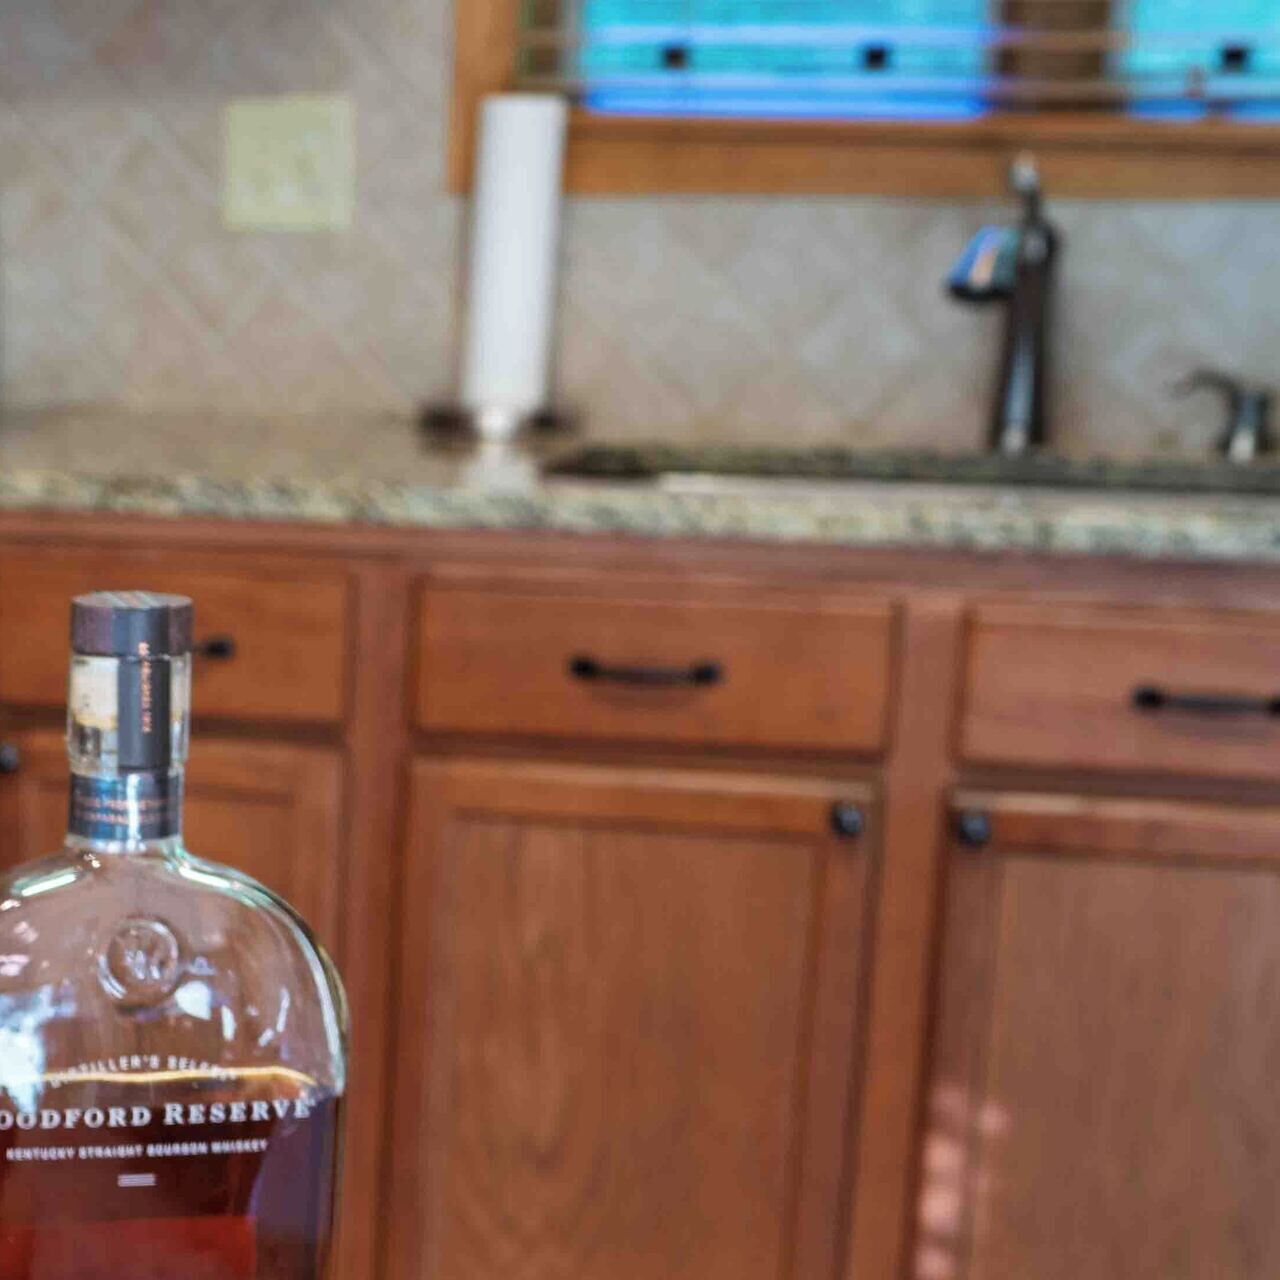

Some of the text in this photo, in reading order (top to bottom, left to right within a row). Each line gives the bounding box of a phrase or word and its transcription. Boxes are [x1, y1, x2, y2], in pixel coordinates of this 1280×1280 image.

[162, 1098, 310, 1127] RESERVE
[5, 1146, 75, 1162] KENTUCKY
[146, 1141, 208, 1158] BOURBON
